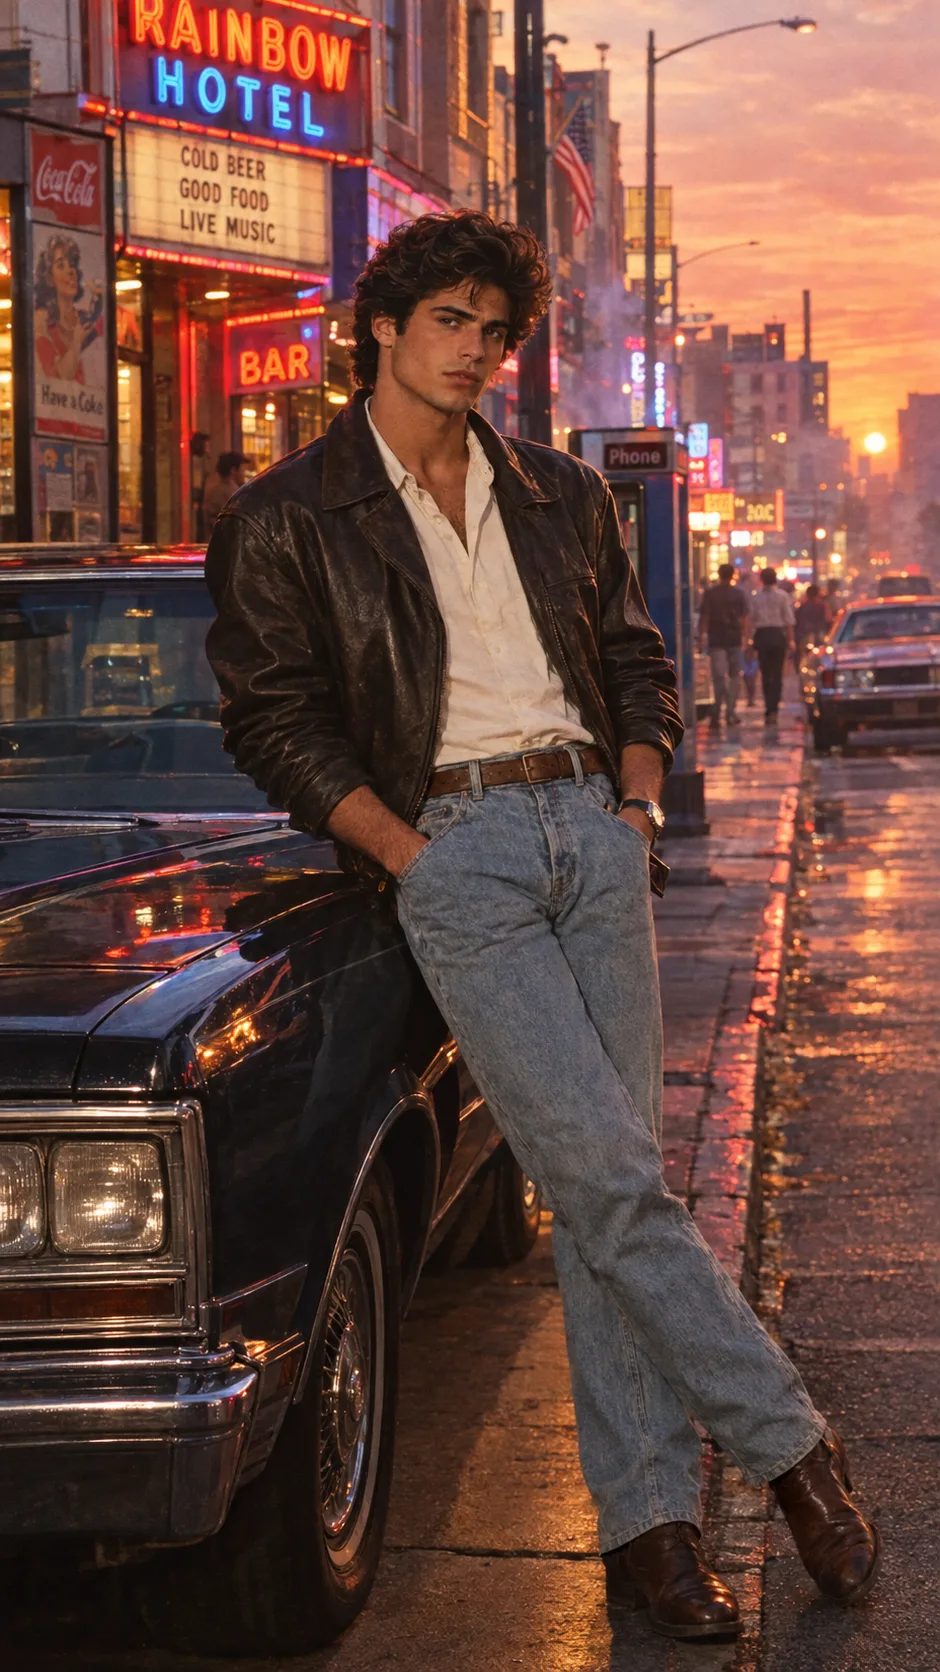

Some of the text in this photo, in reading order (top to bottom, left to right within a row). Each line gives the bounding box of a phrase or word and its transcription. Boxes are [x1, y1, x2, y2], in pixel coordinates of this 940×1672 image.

[131, 0, 351, 92] RAINBOW
[157, 56, 324, 138] HOTEL
[181, 145, 266, 182] COLD BEER
[180, 177, 269, 212] GOOD FOOD
[180, 209, 276, 245] LIVE MUSIC
[238, 344, 312, 386] BAR
[42, 384, 104, 416] Have a Coke
[609, 447, 661, 465] Phone
